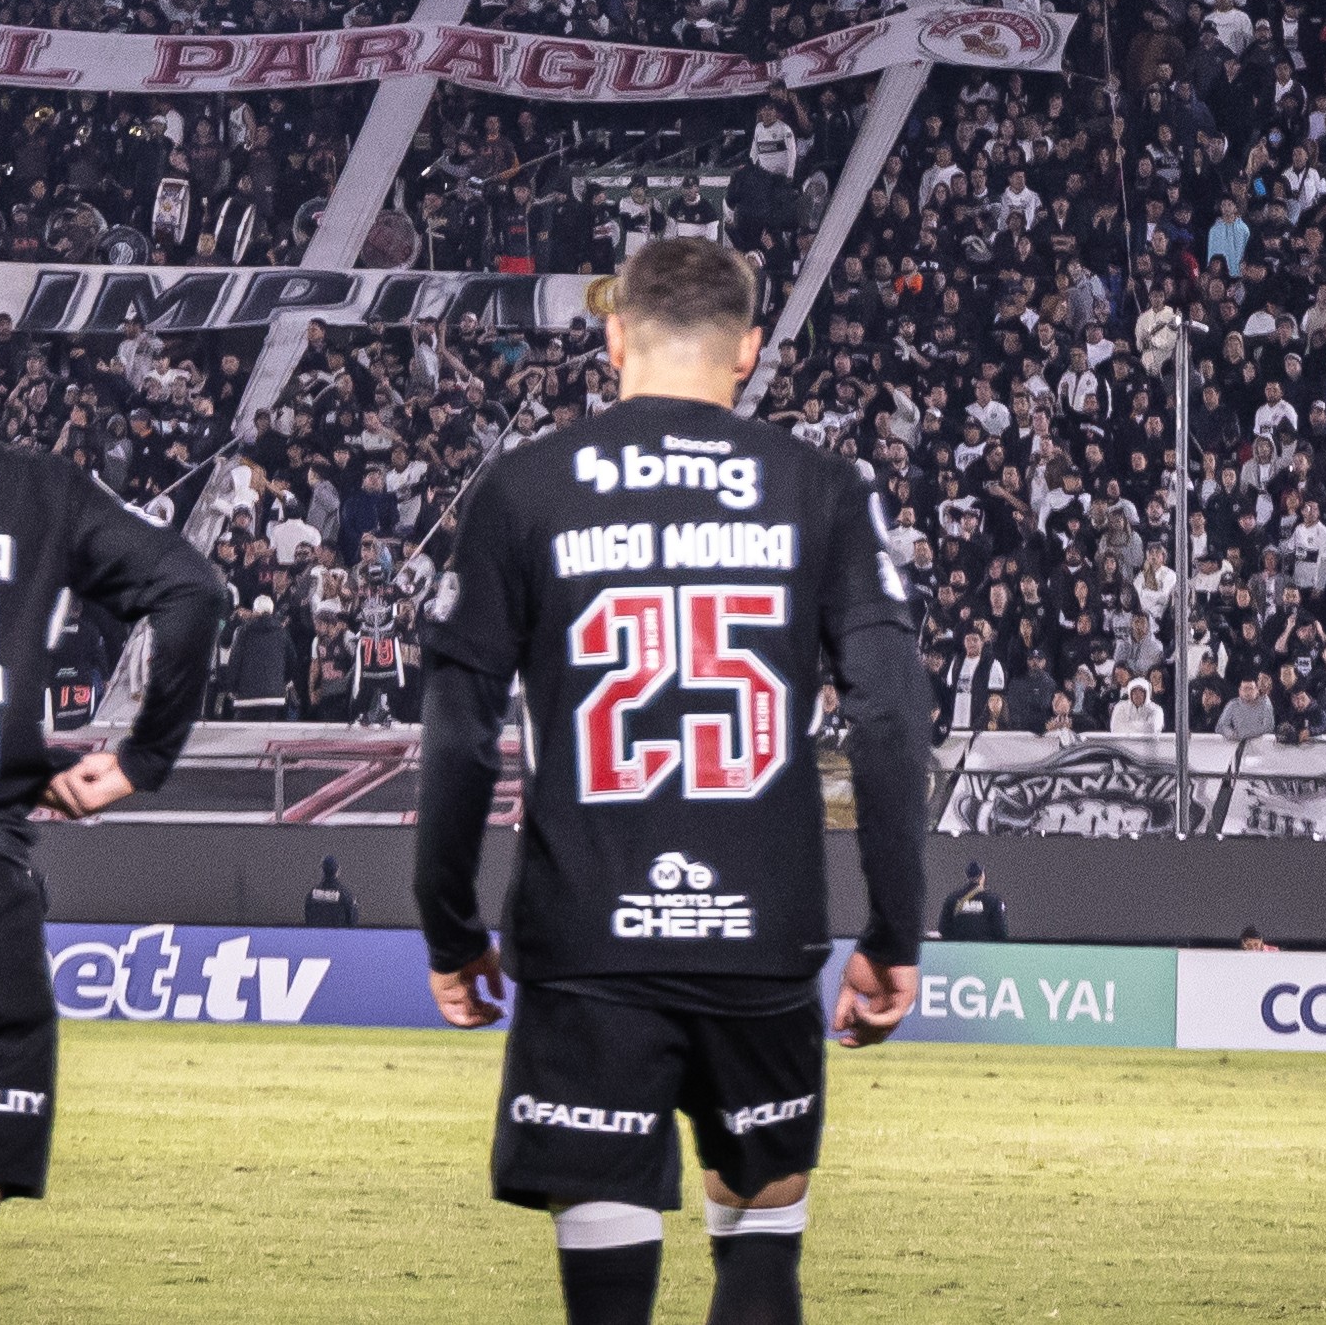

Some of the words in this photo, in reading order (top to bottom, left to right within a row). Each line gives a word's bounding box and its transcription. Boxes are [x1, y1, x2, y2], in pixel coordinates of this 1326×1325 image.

[147, 20, 885, 102] PARAGUAY
[622, 445, 760, 510] bmg
[553, 524, 655, 577] HUGO
[662, 523, 797, 570] MOURA
[568, 585, 787, 804] 25
[613, 907, 752, 938] CHEFE
[913, 976, 1025, 1019] EGA
[1038, 978, 1116, 1024] YA!
[535, 1102, 656, 1134] FACILITY
